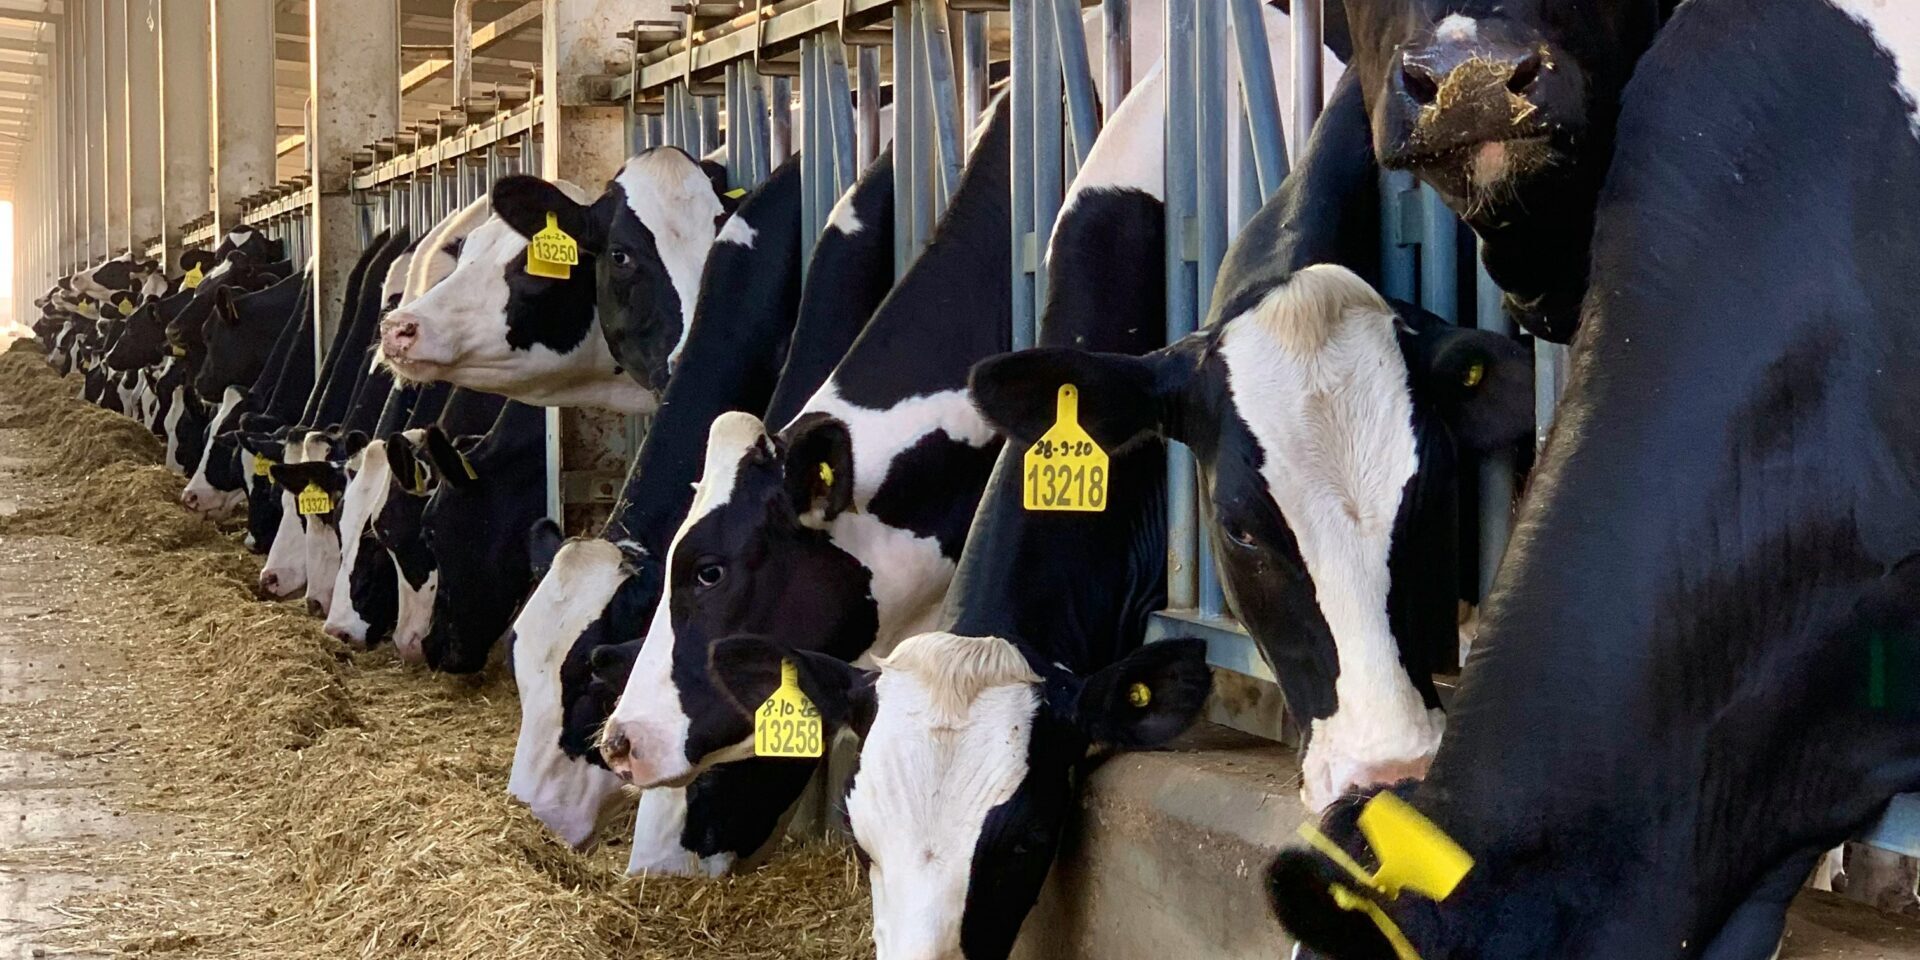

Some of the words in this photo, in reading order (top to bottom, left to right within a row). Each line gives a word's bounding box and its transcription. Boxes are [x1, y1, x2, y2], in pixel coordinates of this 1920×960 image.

[536, 241, 576, 263] 13250
[1028, 464, 1103, 507] 13218
[301, 498, 328, 513] 13327
[758, 719, 819, 754] 13258
